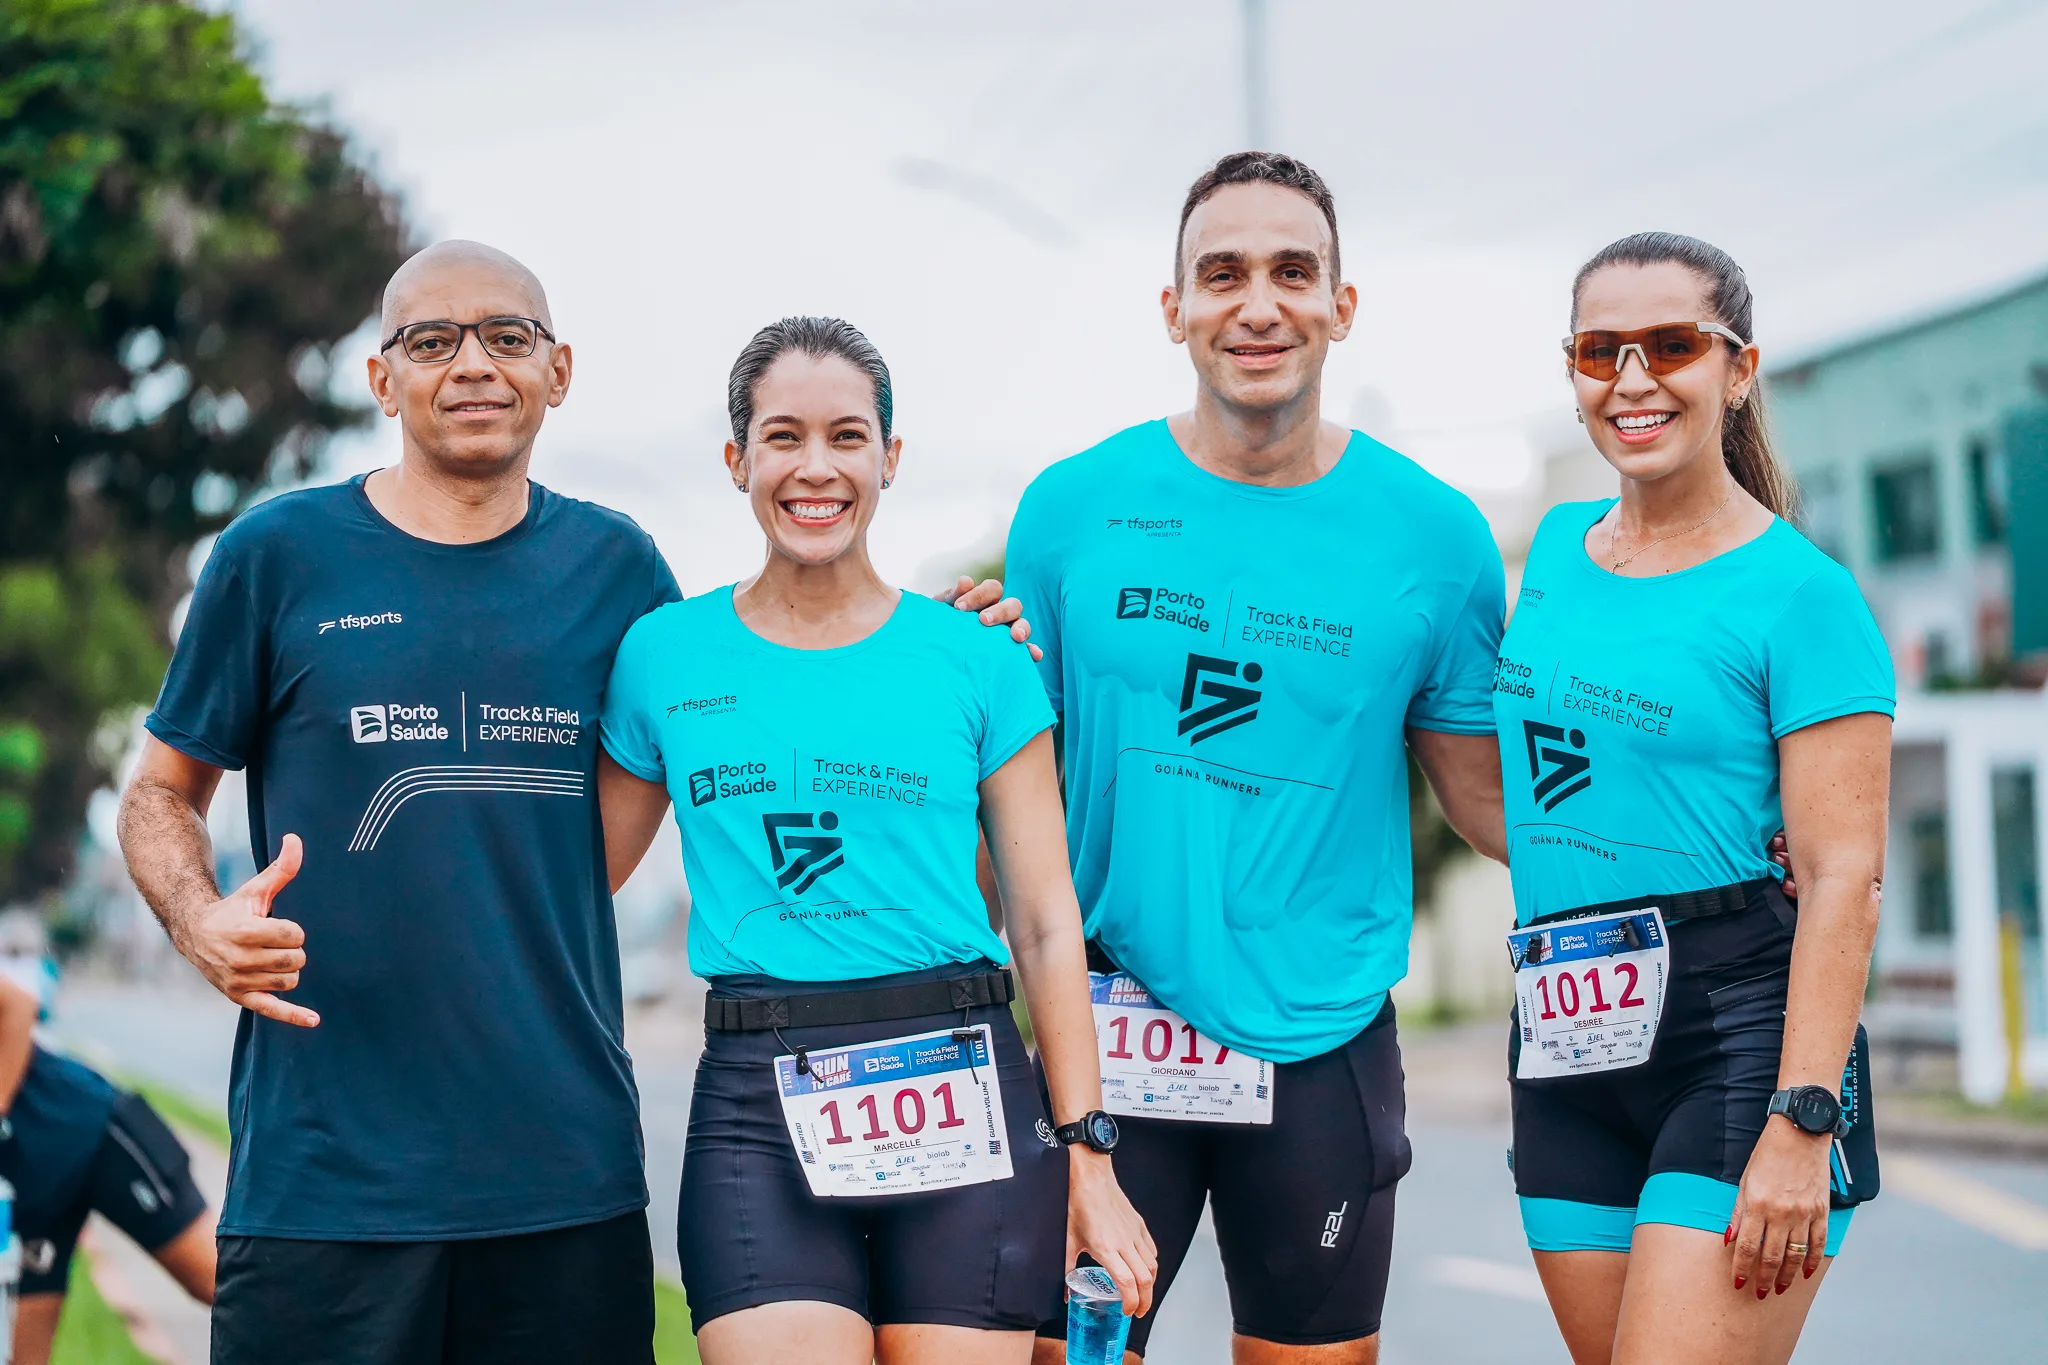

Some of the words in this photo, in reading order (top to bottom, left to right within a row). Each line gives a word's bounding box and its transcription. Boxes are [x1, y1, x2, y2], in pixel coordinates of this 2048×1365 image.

[1127, 517, 1183, 532] tfsports
[1155, 588, 1205, 609] Porto
[339, 611, 403, 630] tfsports
[1153, 605, 1210, 633] Saúde
[1242, 626, 1351, 658] EXPERIENCE
[1501, 657, 1532, 678] Porto
[1498, 677, 1535, 699] Saúde
[389, 704, 439, 721] Porto
[682, 694, 737, 713] tfsports
[1563, 694, 1670, 737] EXPERIENCE
[390, 723, 449, 741] Saúde
[479, 725, 579, 746] EXPERIENCE
[718, 761, 767, 780] Porto
[720, 774, 777, 798] Saúde
[812, 778, 927, 807] EXPERIENCE
[1205, 774, 1261, 796] RUNNERS
[1529, 835, 1563, 846] GOIÂNIA
[1567, 837, 1617, 861] RUNNERS
[1646, 921, 1659, 941] 1012
[1570, 940, 1588, 949] Saúde
[1109, 994, 1121, 1004] TO
[1122, 994, 1148, 1003] CARE
[1536, 962, 1645, 1020] 1012
[1573, 1017, 1604, 1029] DESIRÉE
[1613, 1029, 1633, 1038] biolab
[879, 1055, 900, 1063] Porto
[916, 1052, 960, 1065] EXPERIENCE
[975, 1039, 985, 1060] 1101
[811, 1053, 850, 1080] RUN
[880, 1061, 904, 1071] Saúde
[1151, 1066, 1197, 1077] GIORDANO
[782, 1070, 793, 1090] 1101
[826, 1070, 851, 1087] CARE
[1167, 1083, 1188, 1092] AJEL
[1199, 1084, 1220, 1092] biolab
[819, 1082, 965, 1146] 1101
[982, 1081, 995, 1138] GUARDA-VOLUME
[795, 1122, 807, 1148] SORTEIO
[873, 1138, 922, 1153] MARCELLE
[927, 1150, 950, 1159] biolab
[895, 1156, 916, 1166] AJEL
[1321, 1201, 1348, 1248] R2L
